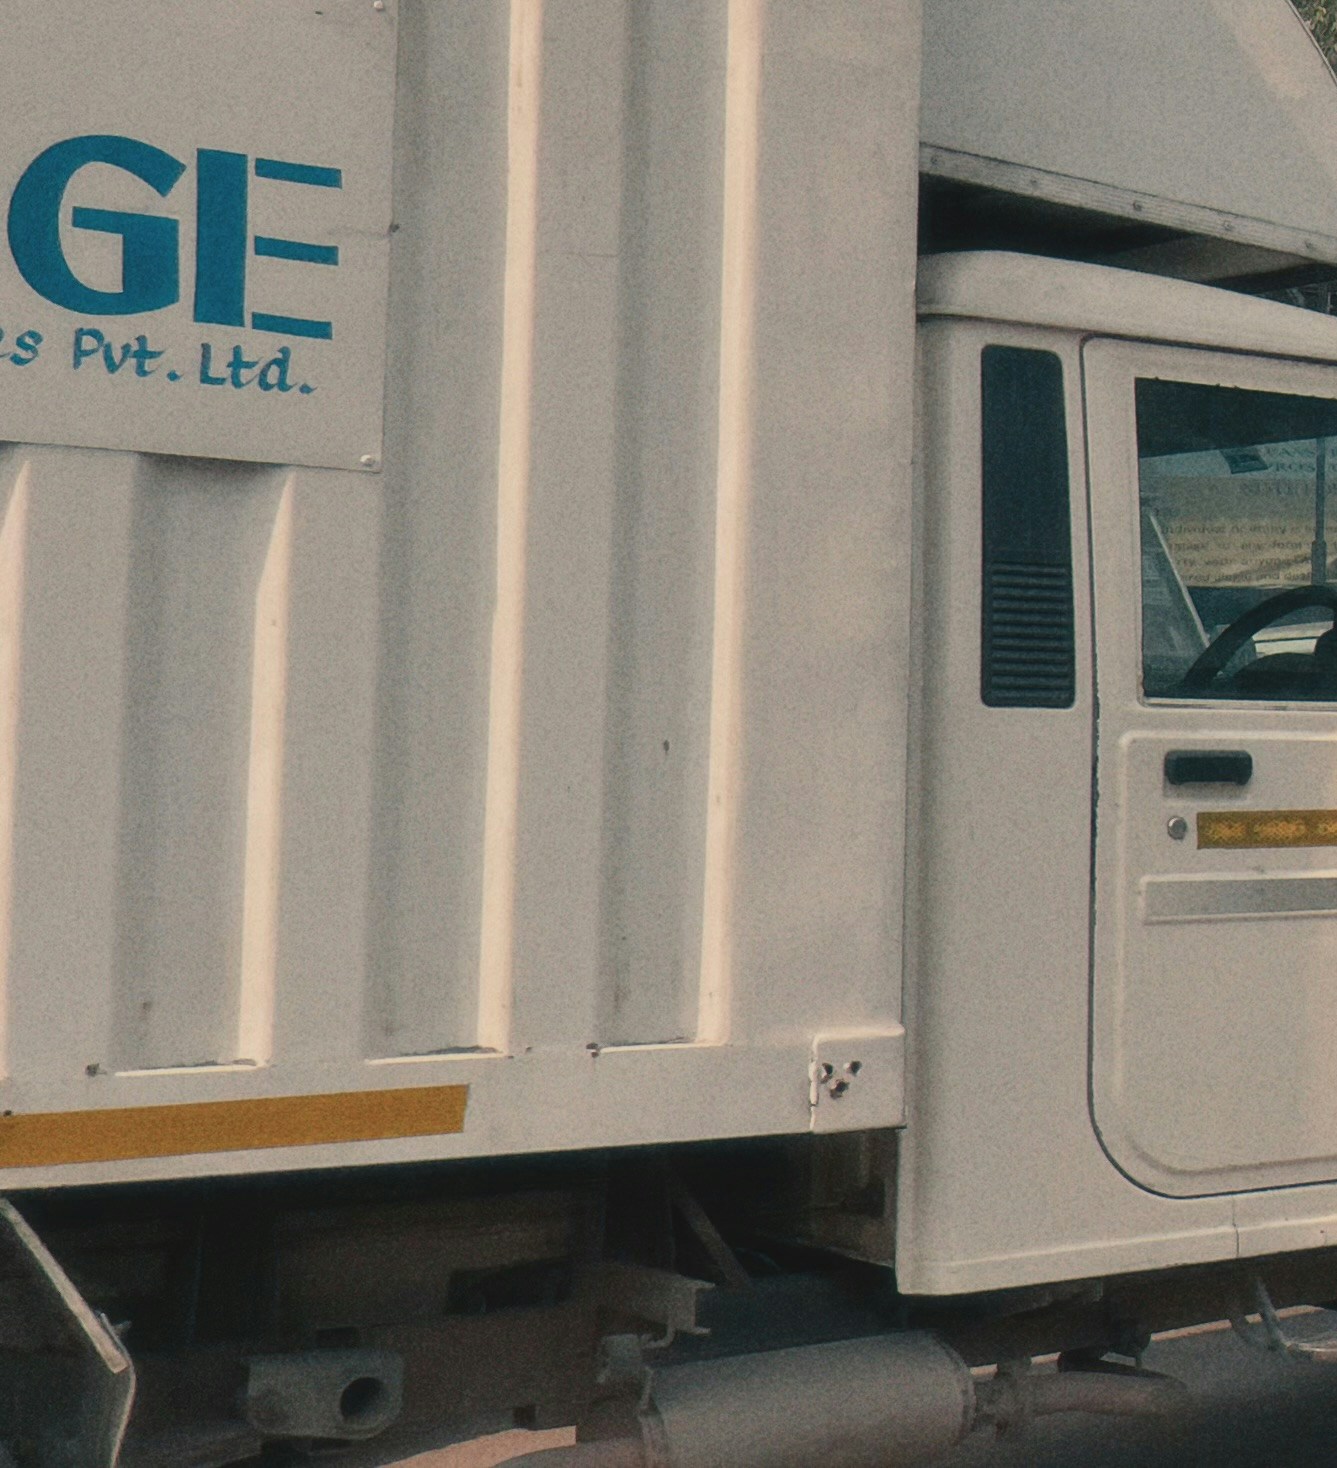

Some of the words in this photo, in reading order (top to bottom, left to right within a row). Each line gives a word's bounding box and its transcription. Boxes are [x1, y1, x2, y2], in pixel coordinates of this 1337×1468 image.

[7, 134, 342, 340] GE
[0, 327, 43, 367] s
[73, 327, 183, 382] Pvt.
[200, 342, 317, 394] Ltd.
